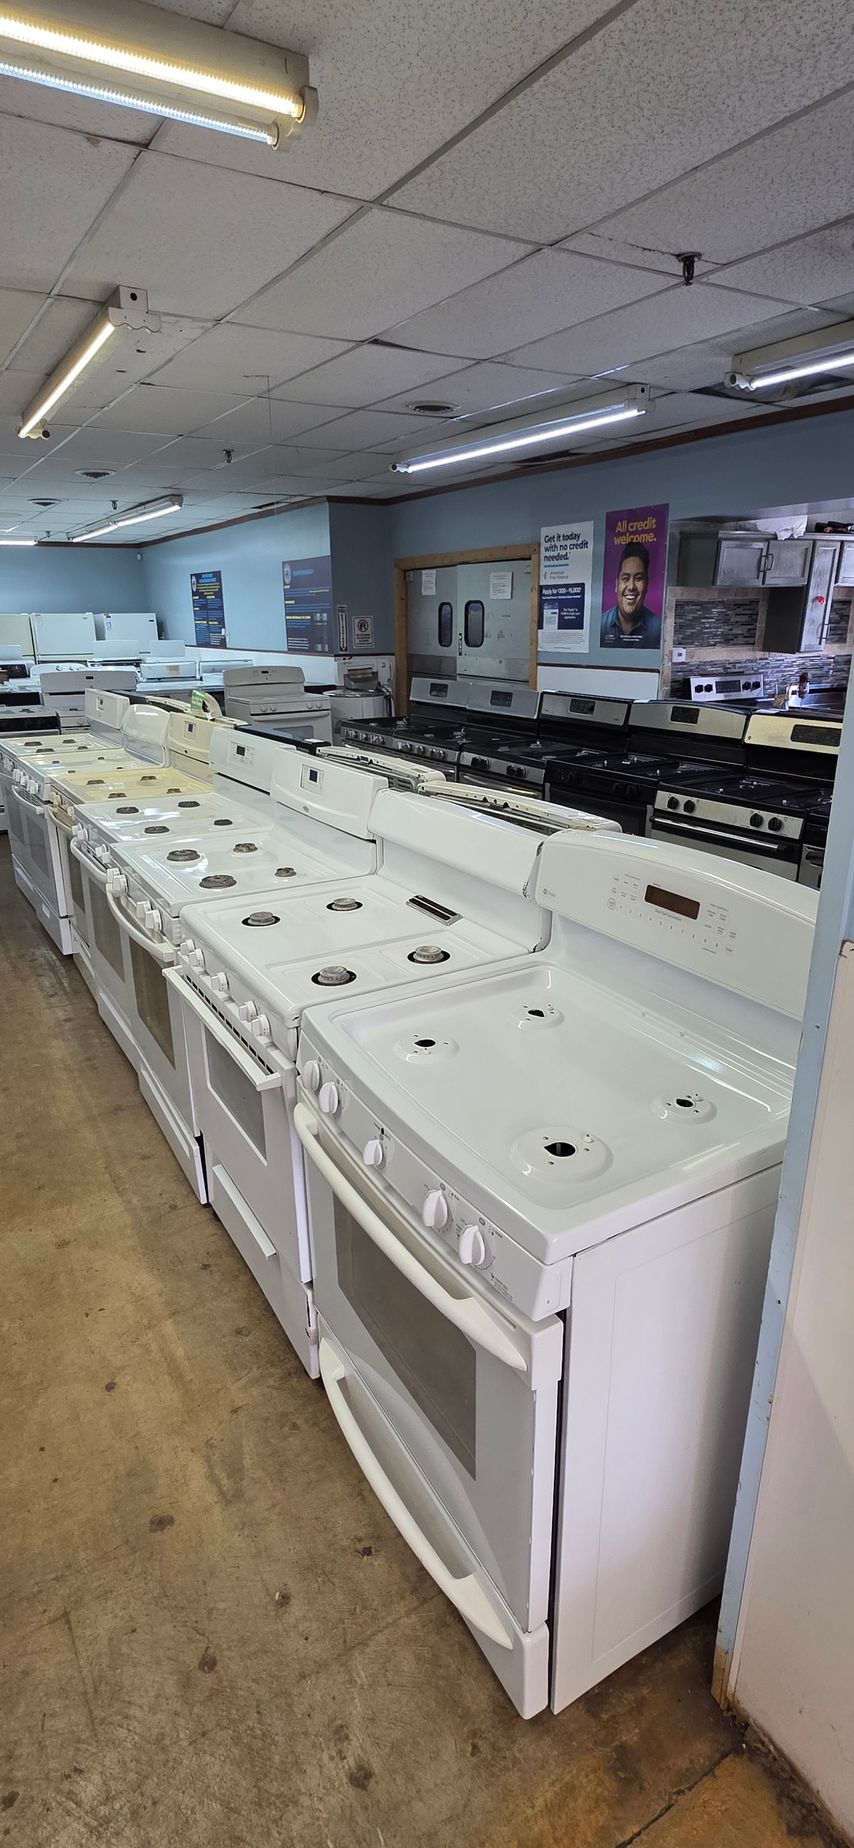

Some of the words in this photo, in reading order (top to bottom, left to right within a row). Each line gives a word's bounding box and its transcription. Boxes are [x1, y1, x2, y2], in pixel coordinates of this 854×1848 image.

[616, 520, 627, 533] All
[628, 516, 657, 531] credit
[544, 534, 556, 543] Get
[556, 532, 562, 542] it
[562, 531, 582, 542] today
[613, 532, 657, 545] welcome.
[544, 543, 559, 553] with
[559, 543, 568, 551] no
[568, 539, 589, 550] credit
